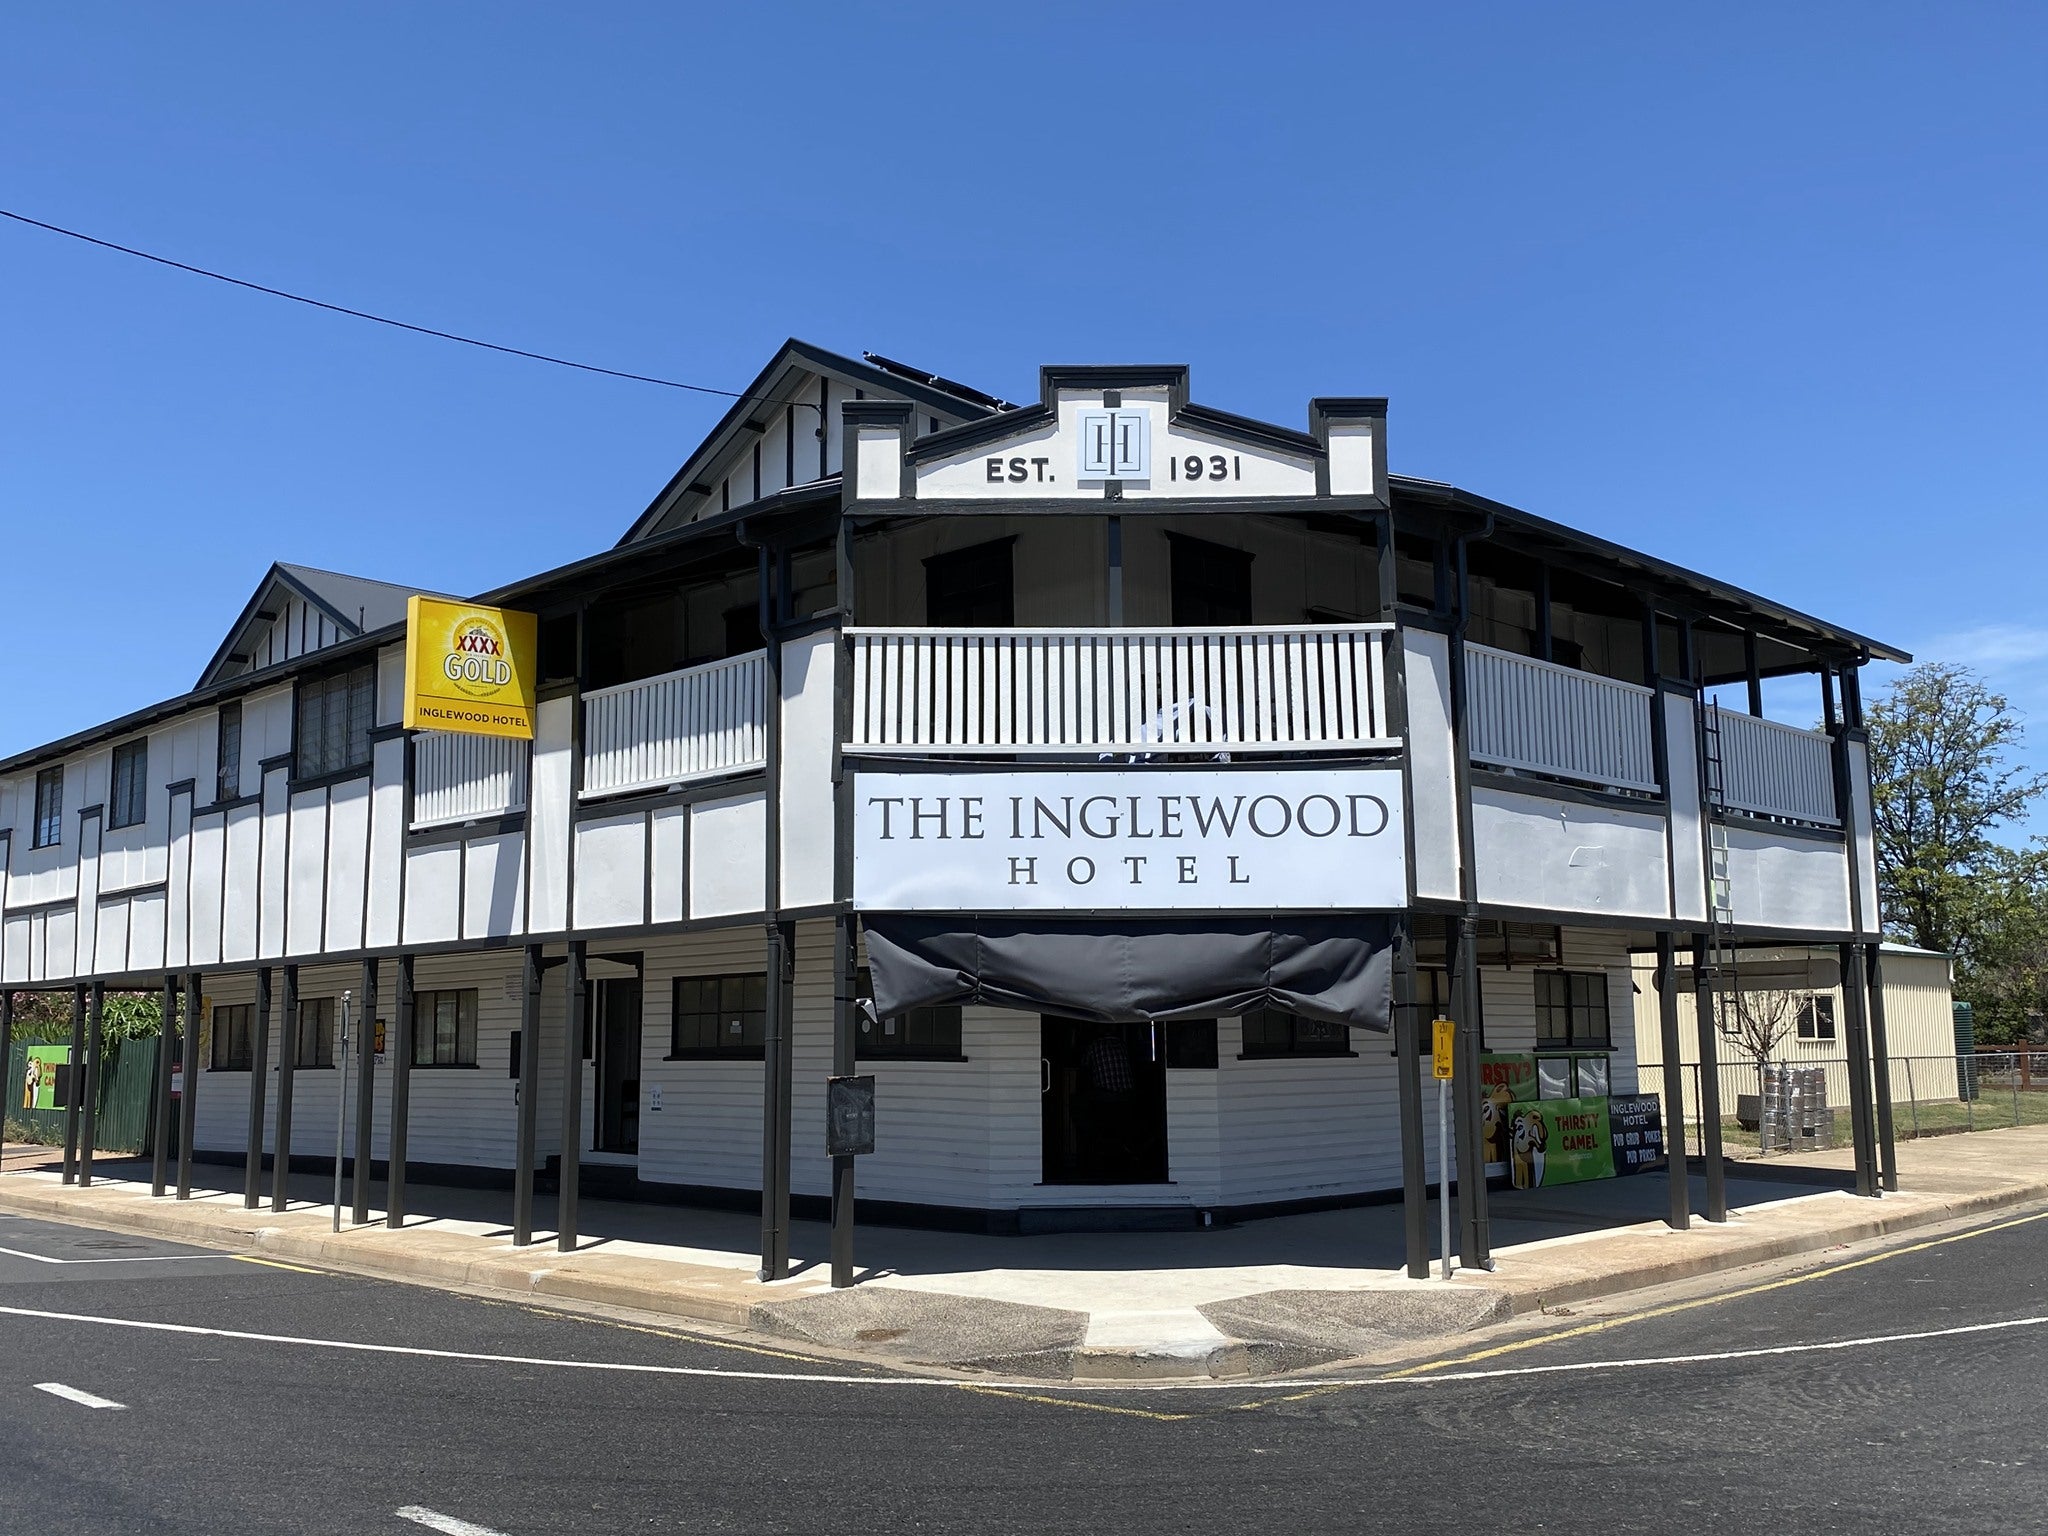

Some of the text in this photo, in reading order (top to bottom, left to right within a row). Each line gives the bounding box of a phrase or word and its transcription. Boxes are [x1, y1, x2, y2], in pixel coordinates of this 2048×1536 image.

[986, 455, 1241, 484] EST. 1931
[456, 635, 501, 656] XXXX
[444, 653, 511, 686] GOLD
[419, 707, 527, 727] INGLEWOOD HOTEL
[868, 794, 1389, 840] THE INGLEWOOD
[1007, 855, 1250, 884] HOTEL
[1611, 1102, 1658, 1115] INGLEWOOD
[1555, 1113, 1600, 1132] THIRSTY
[1623, 1115, 1648, 1126] HOTEL
[1562, 1135, 1599, 1151] CAMEL
